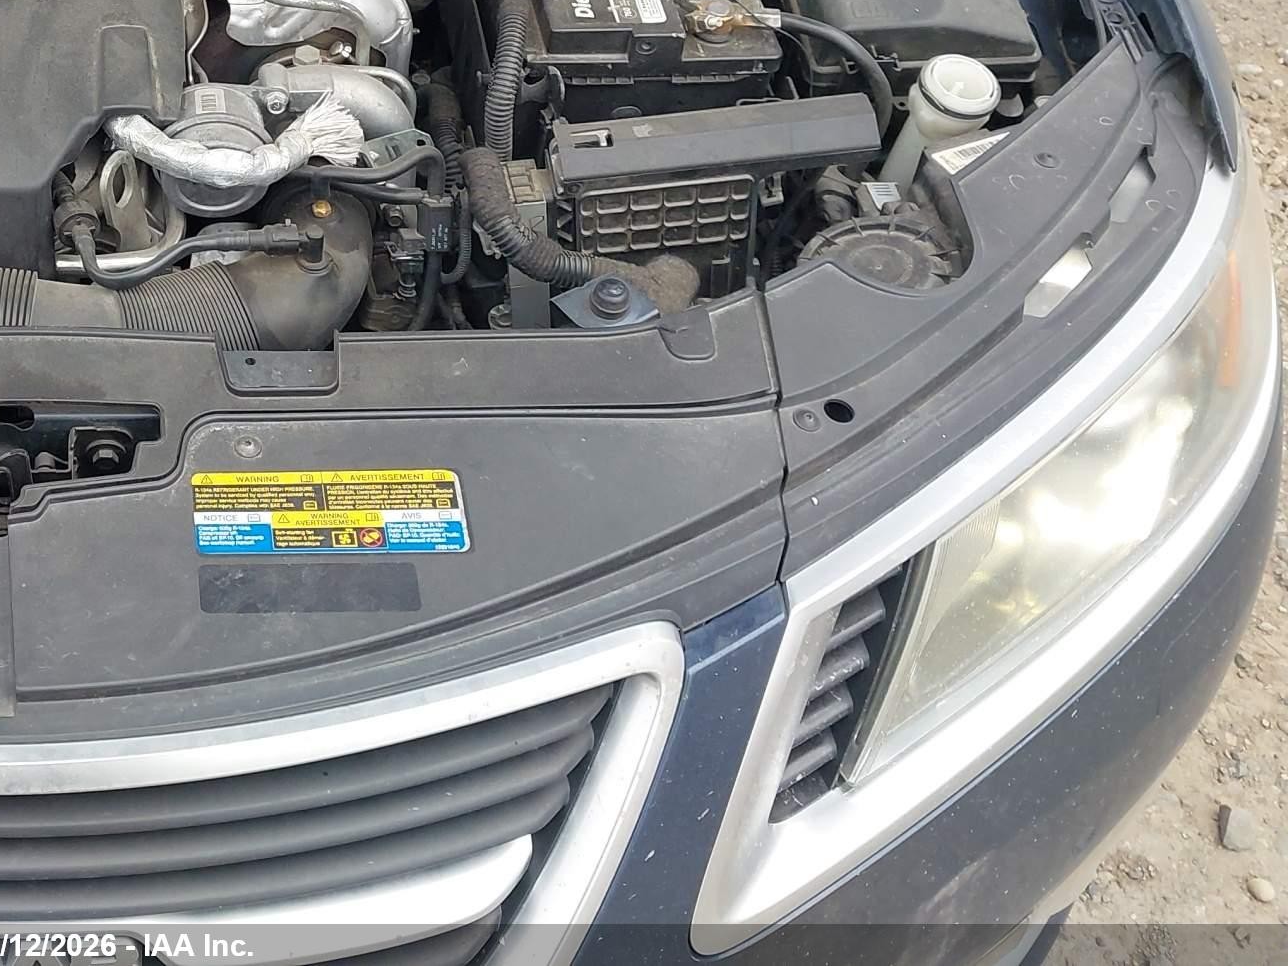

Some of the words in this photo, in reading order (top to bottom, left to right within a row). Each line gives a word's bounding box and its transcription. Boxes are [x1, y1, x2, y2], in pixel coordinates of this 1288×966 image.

[235, 475, 279, 483] WARNING
[350, 473, 425, 481] AVERTISSEMENT
[203, 514, 238, 522] NOTICE
